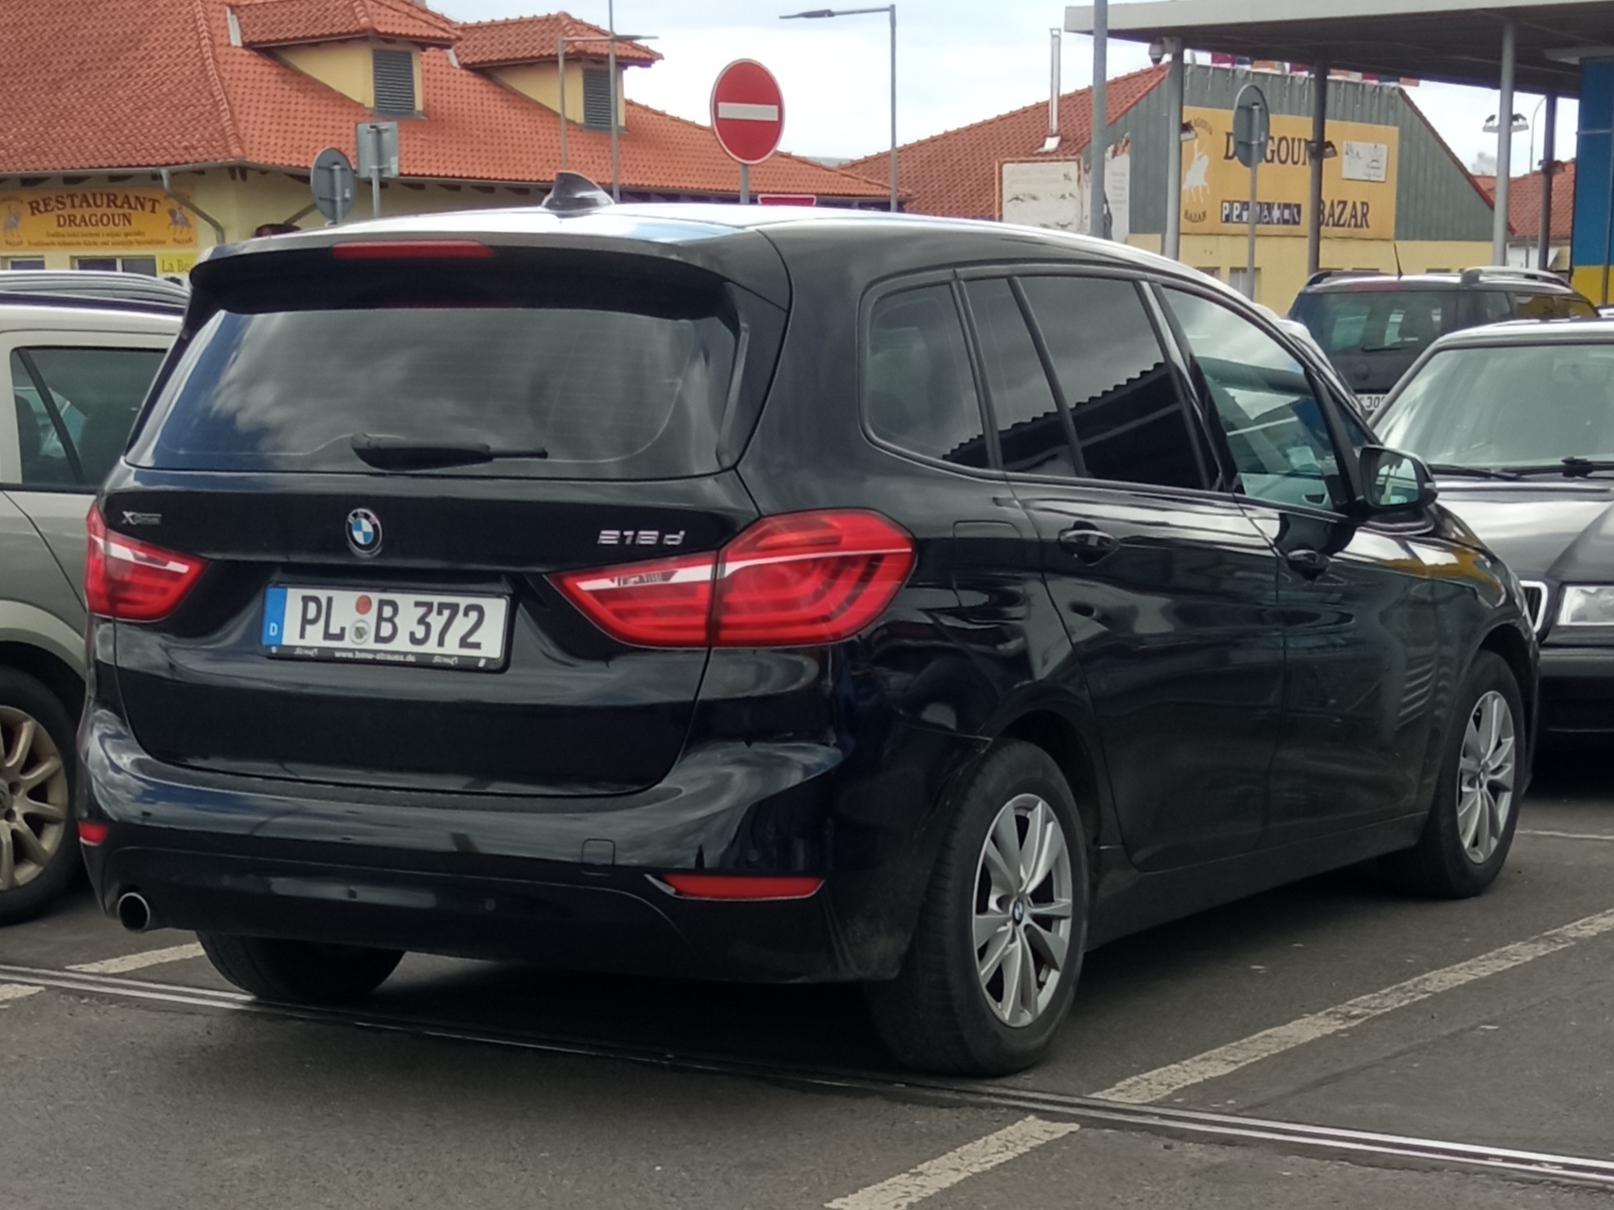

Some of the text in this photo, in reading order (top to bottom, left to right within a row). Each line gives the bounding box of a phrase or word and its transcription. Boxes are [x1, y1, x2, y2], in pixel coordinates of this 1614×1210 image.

[1223, 132, 1311, 166] DGOU
[27, 192, 160, 216] RESTAURANT
[1318, 200, 1370, 229] BAZAR
[56, 213, 132, 228] DRAGOUN
[269, 622, 278, 636] D
[299, 595, 486, 650] PL B 372
